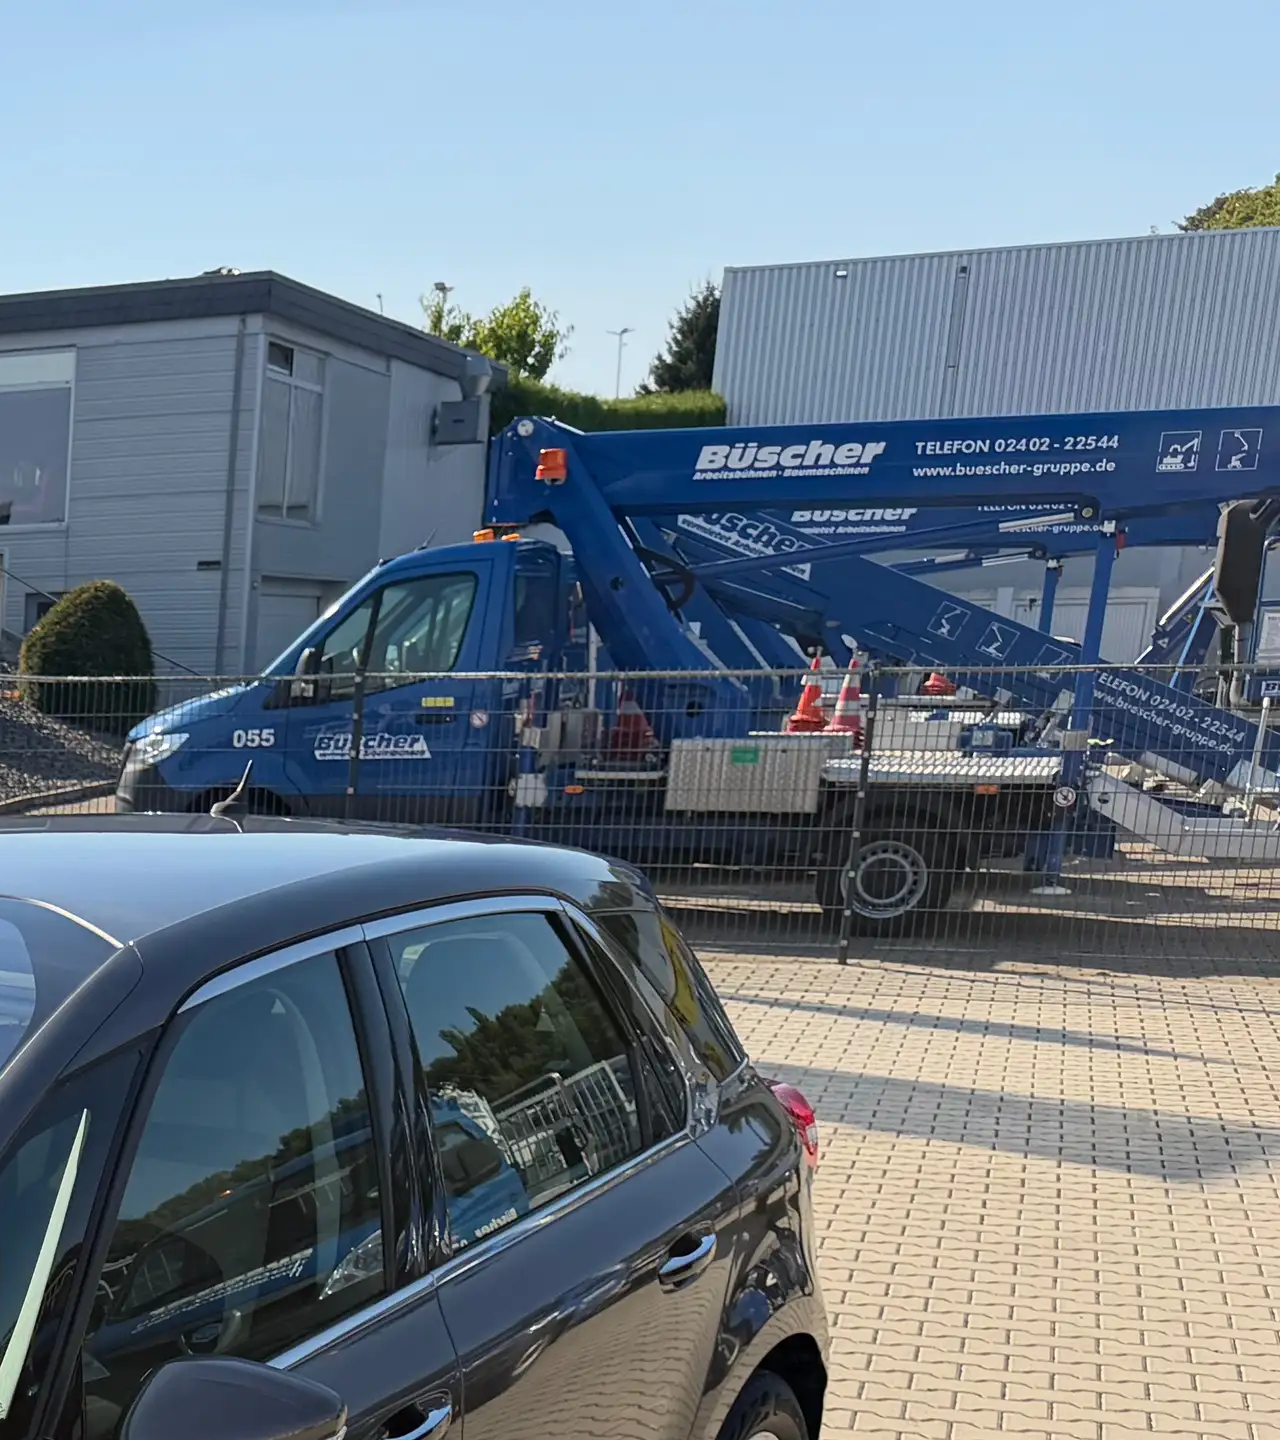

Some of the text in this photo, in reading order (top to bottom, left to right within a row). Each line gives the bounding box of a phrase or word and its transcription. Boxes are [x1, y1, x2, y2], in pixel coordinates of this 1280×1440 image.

[915, 440, 991, 455] TELEFON
[994, 437, 1050, 453] 02402
[1064, 435, 1120, 451] 22544
[695, 440, 886, 471] Büscher
[693, 467, 778, 480] Arbeitsbühnen
[913, 459, 1116, 478] www.buescher-gruppe.de
[233, 728, 275, 748] 055
